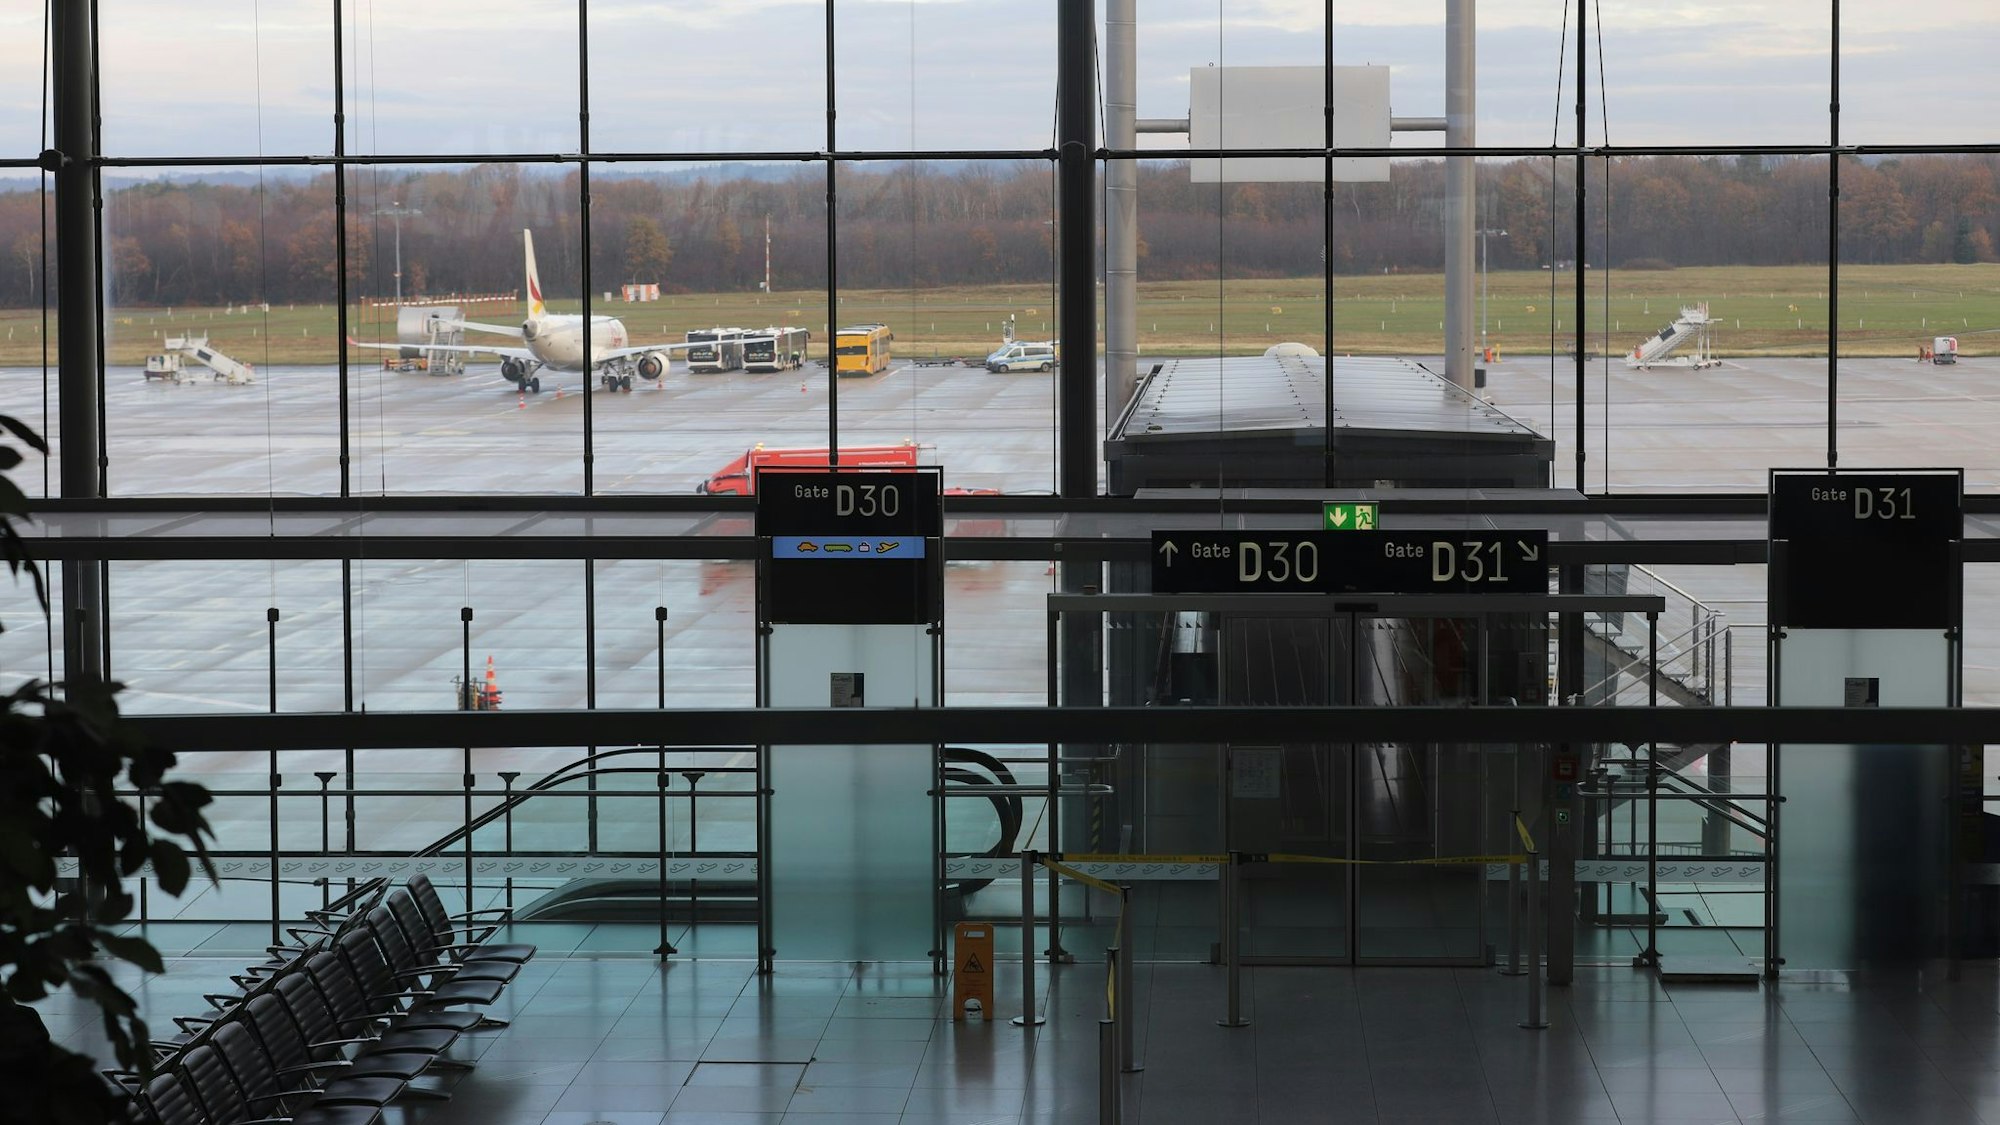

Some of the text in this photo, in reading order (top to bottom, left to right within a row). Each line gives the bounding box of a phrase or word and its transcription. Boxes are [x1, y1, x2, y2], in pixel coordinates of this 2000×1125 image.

[794, 485, 899, 516] Gate D30
[1811, 487, 1916, 519] Gate D31
[1191, 541, 1318, 582] Gate D30
[1384, 541, 1509, 582] Gate D31
